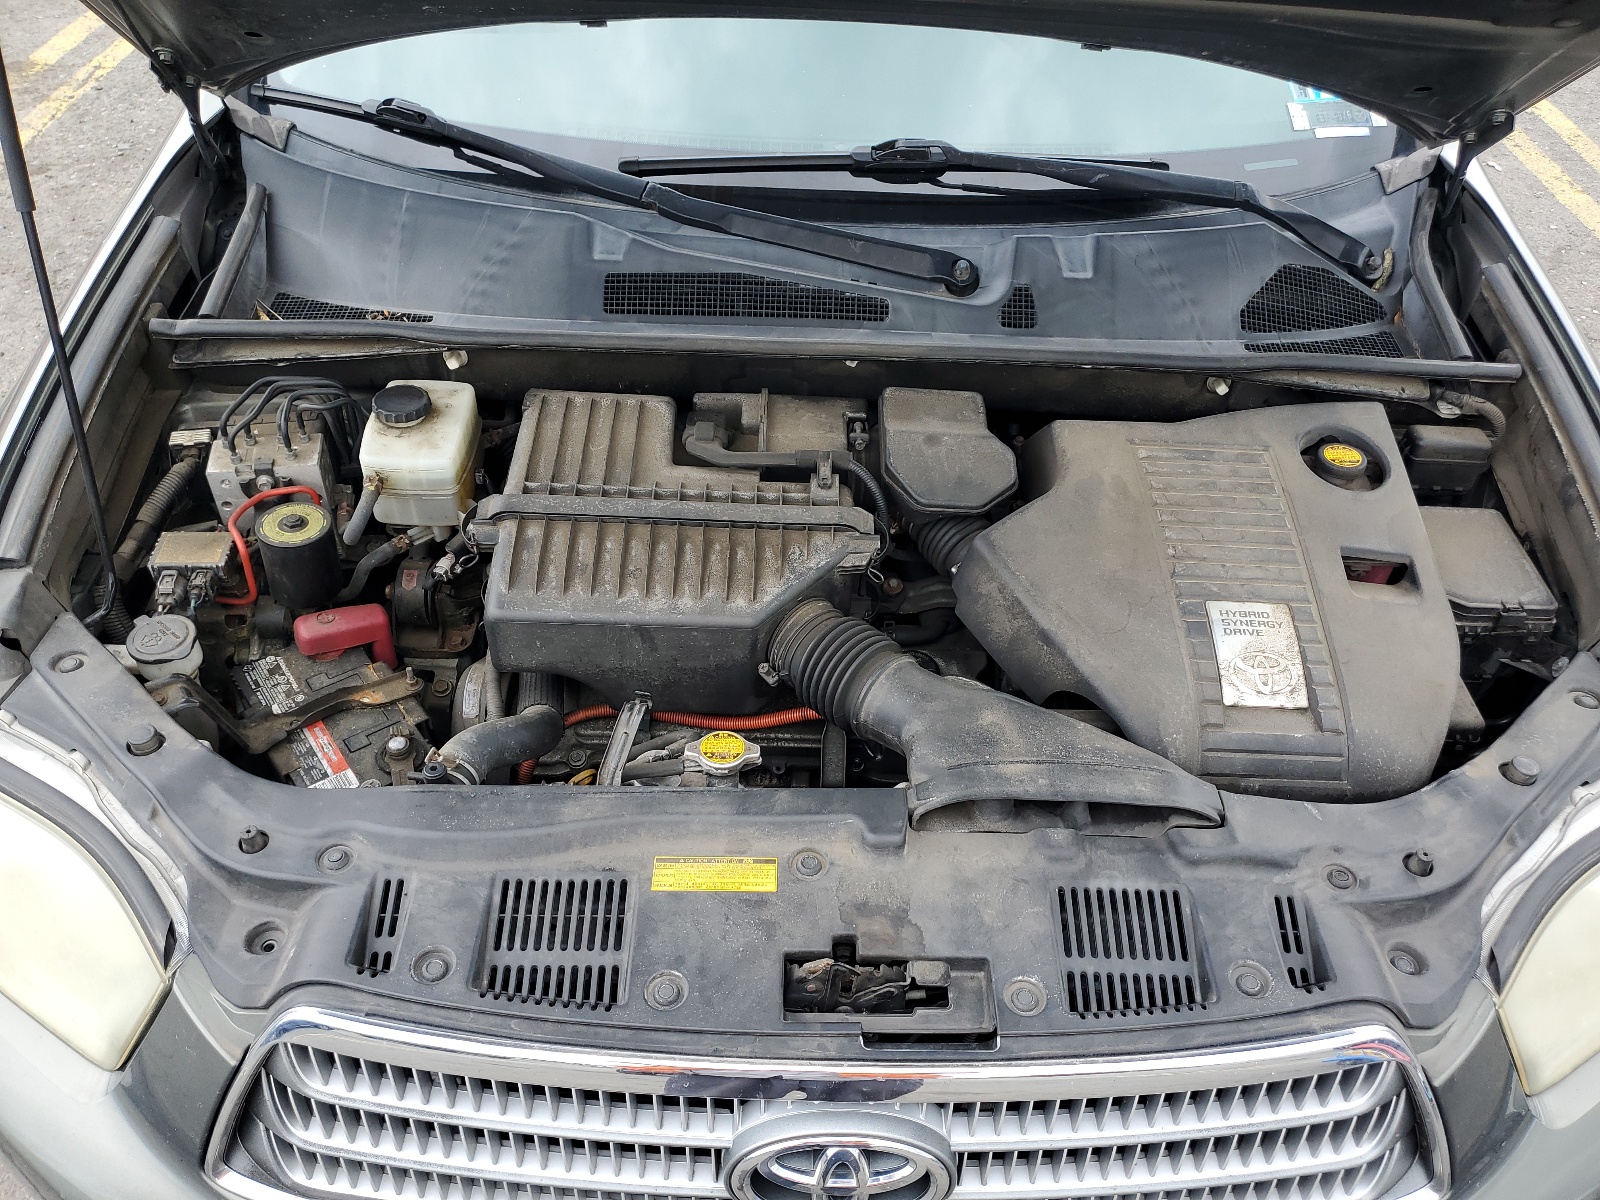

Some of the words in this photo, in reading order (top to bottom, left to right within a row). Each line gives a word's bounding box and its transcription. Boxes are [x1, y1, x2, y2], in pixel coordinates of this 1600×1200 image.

[1219, 610, 1270, 619] HYBRID
[1221, 618, 1283, 628] SYNERGY
[1223, 628, 1265, 636] DRIVE
